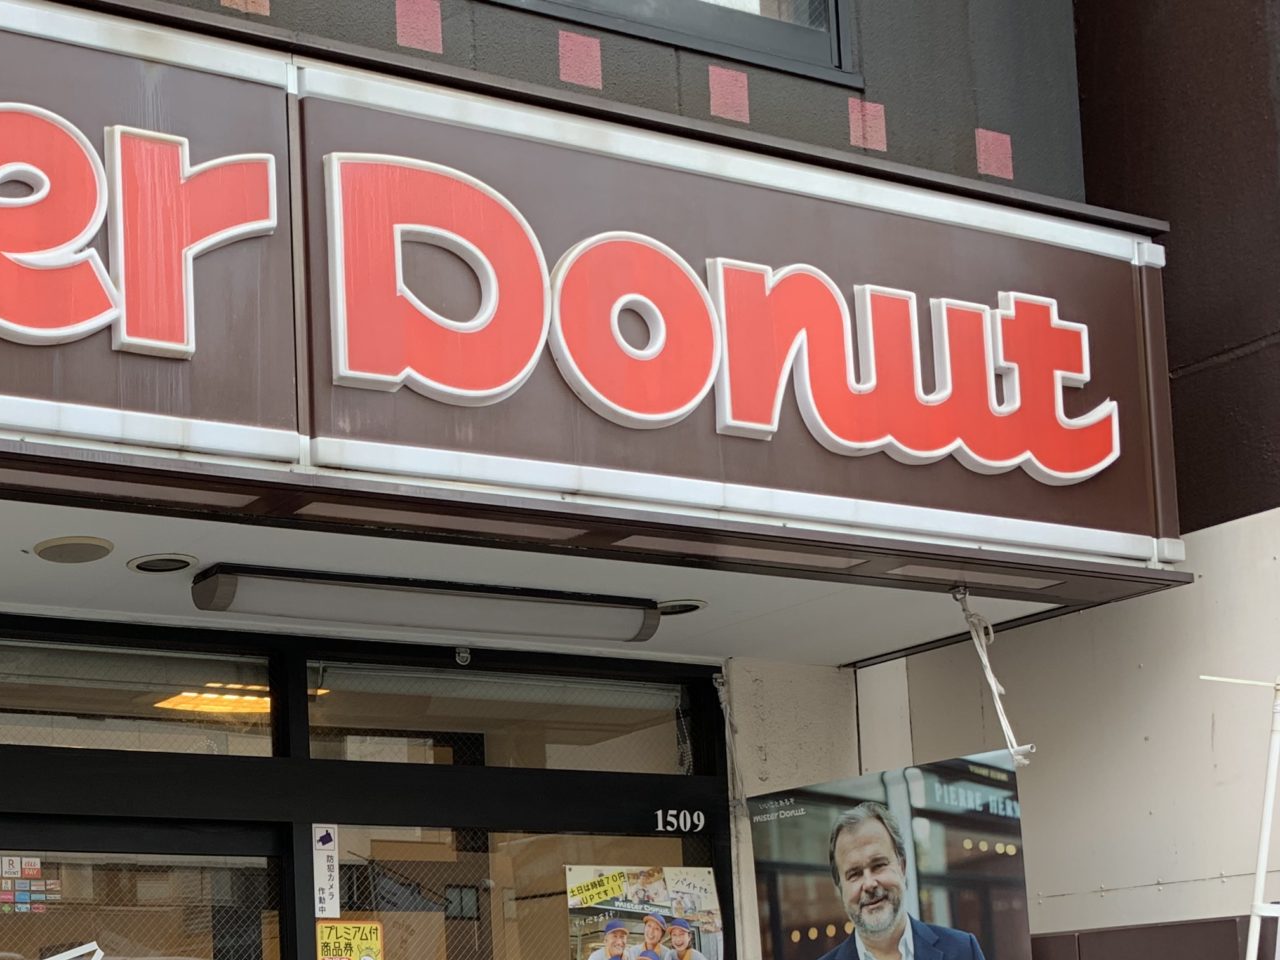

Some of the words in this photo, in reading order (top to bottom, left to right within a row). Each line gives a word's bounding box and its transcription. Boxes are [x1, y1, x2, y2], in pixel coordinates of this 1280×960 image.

[324, 152, 1120, 486] Donut
[654, 809, 706, 833] 1509
[326, 854, 335, 901] 防犯カメラ
[318, 887, 327, 914] 作動中
[324, 927, 379, 942] プレミアム付
[321, 942, 354, 958] 商品券
